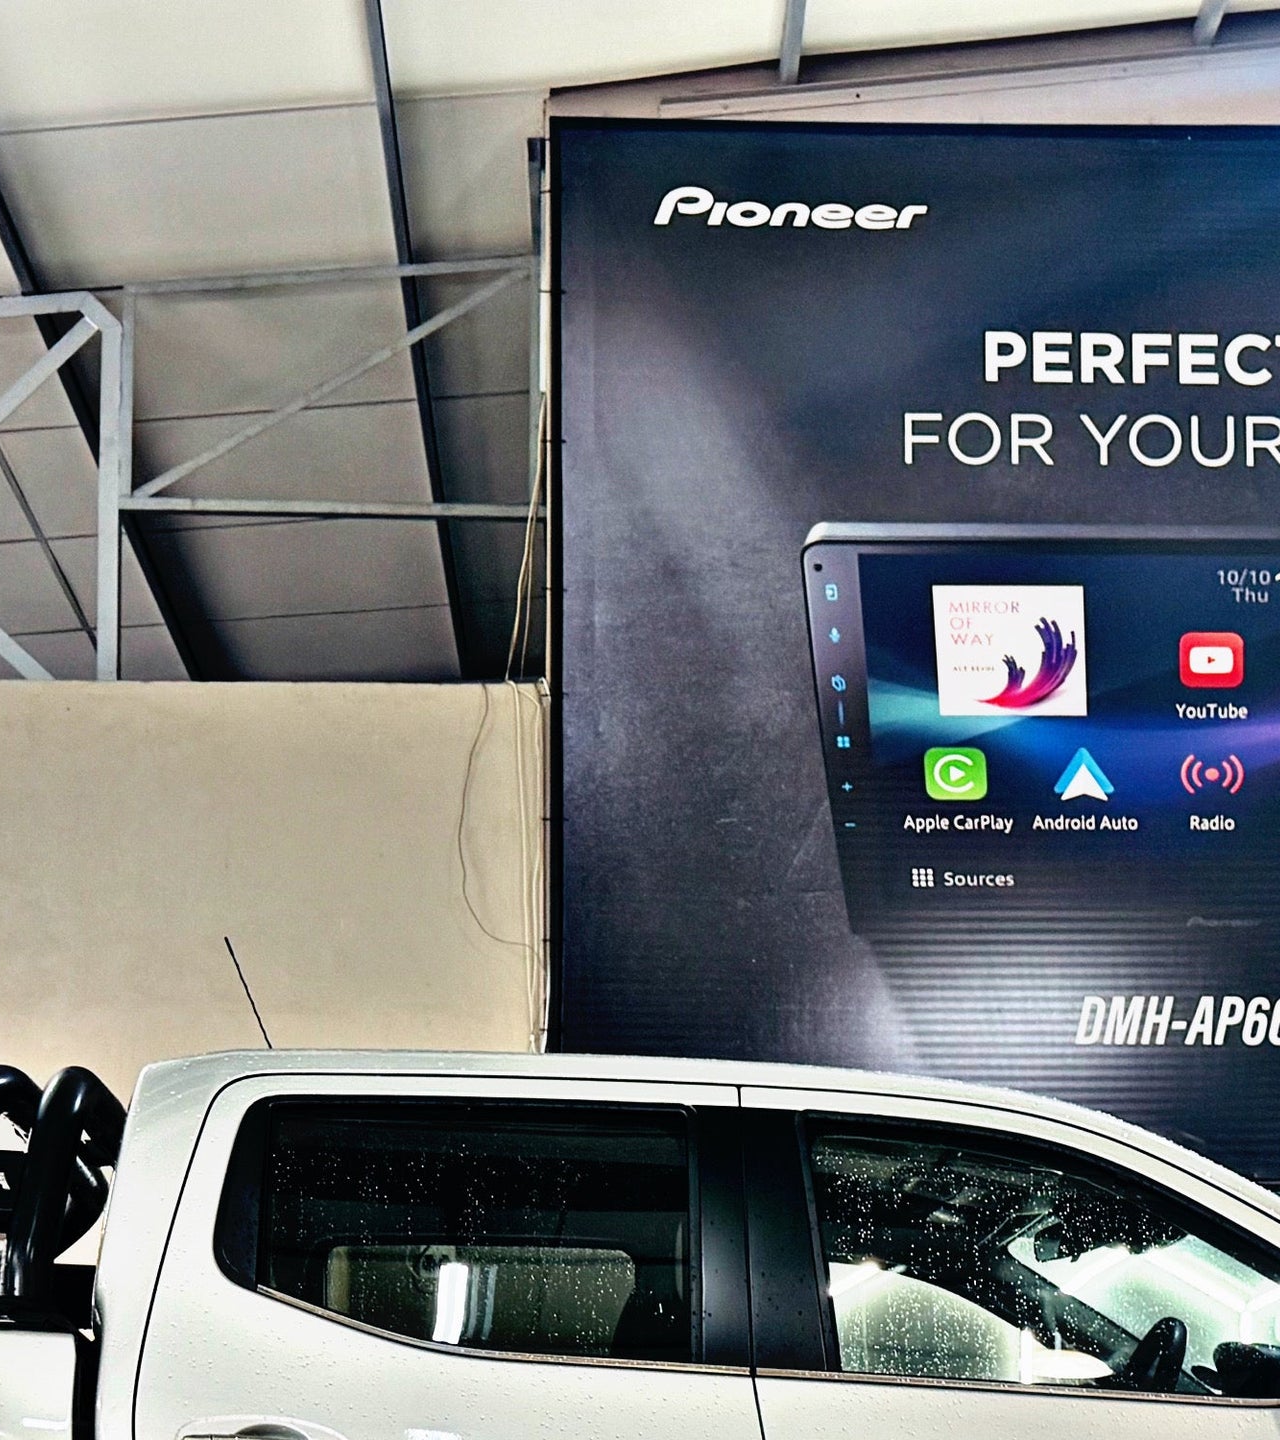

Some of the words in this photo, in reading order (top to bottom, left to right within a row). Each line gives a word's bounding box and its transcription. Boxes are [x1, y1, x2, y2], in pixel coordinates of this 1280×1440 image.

[653, 186, 928, 230] Pioneer
[904, 412, 1054, 466] FOR
[1217, 569, 1271, 586] 10/10
[1231, 588, 1269, 603] Thu
[948, 600, 1021, 614] MIRROR
[949, 616, 971, 631] OF
[950, 632, 994, 646] WAY
[1175, 703, 1248, 720] YouTube
[903, 814, 949, 834] Apple
[953, 814, 1014, 834] CarPlay
[1032, 814, 1096, 831] Android
[1099, 815, 1138, 831] Auto
[1189, 814, 1235, 831] Radio
[943, 870, 1015, 887] Sources
